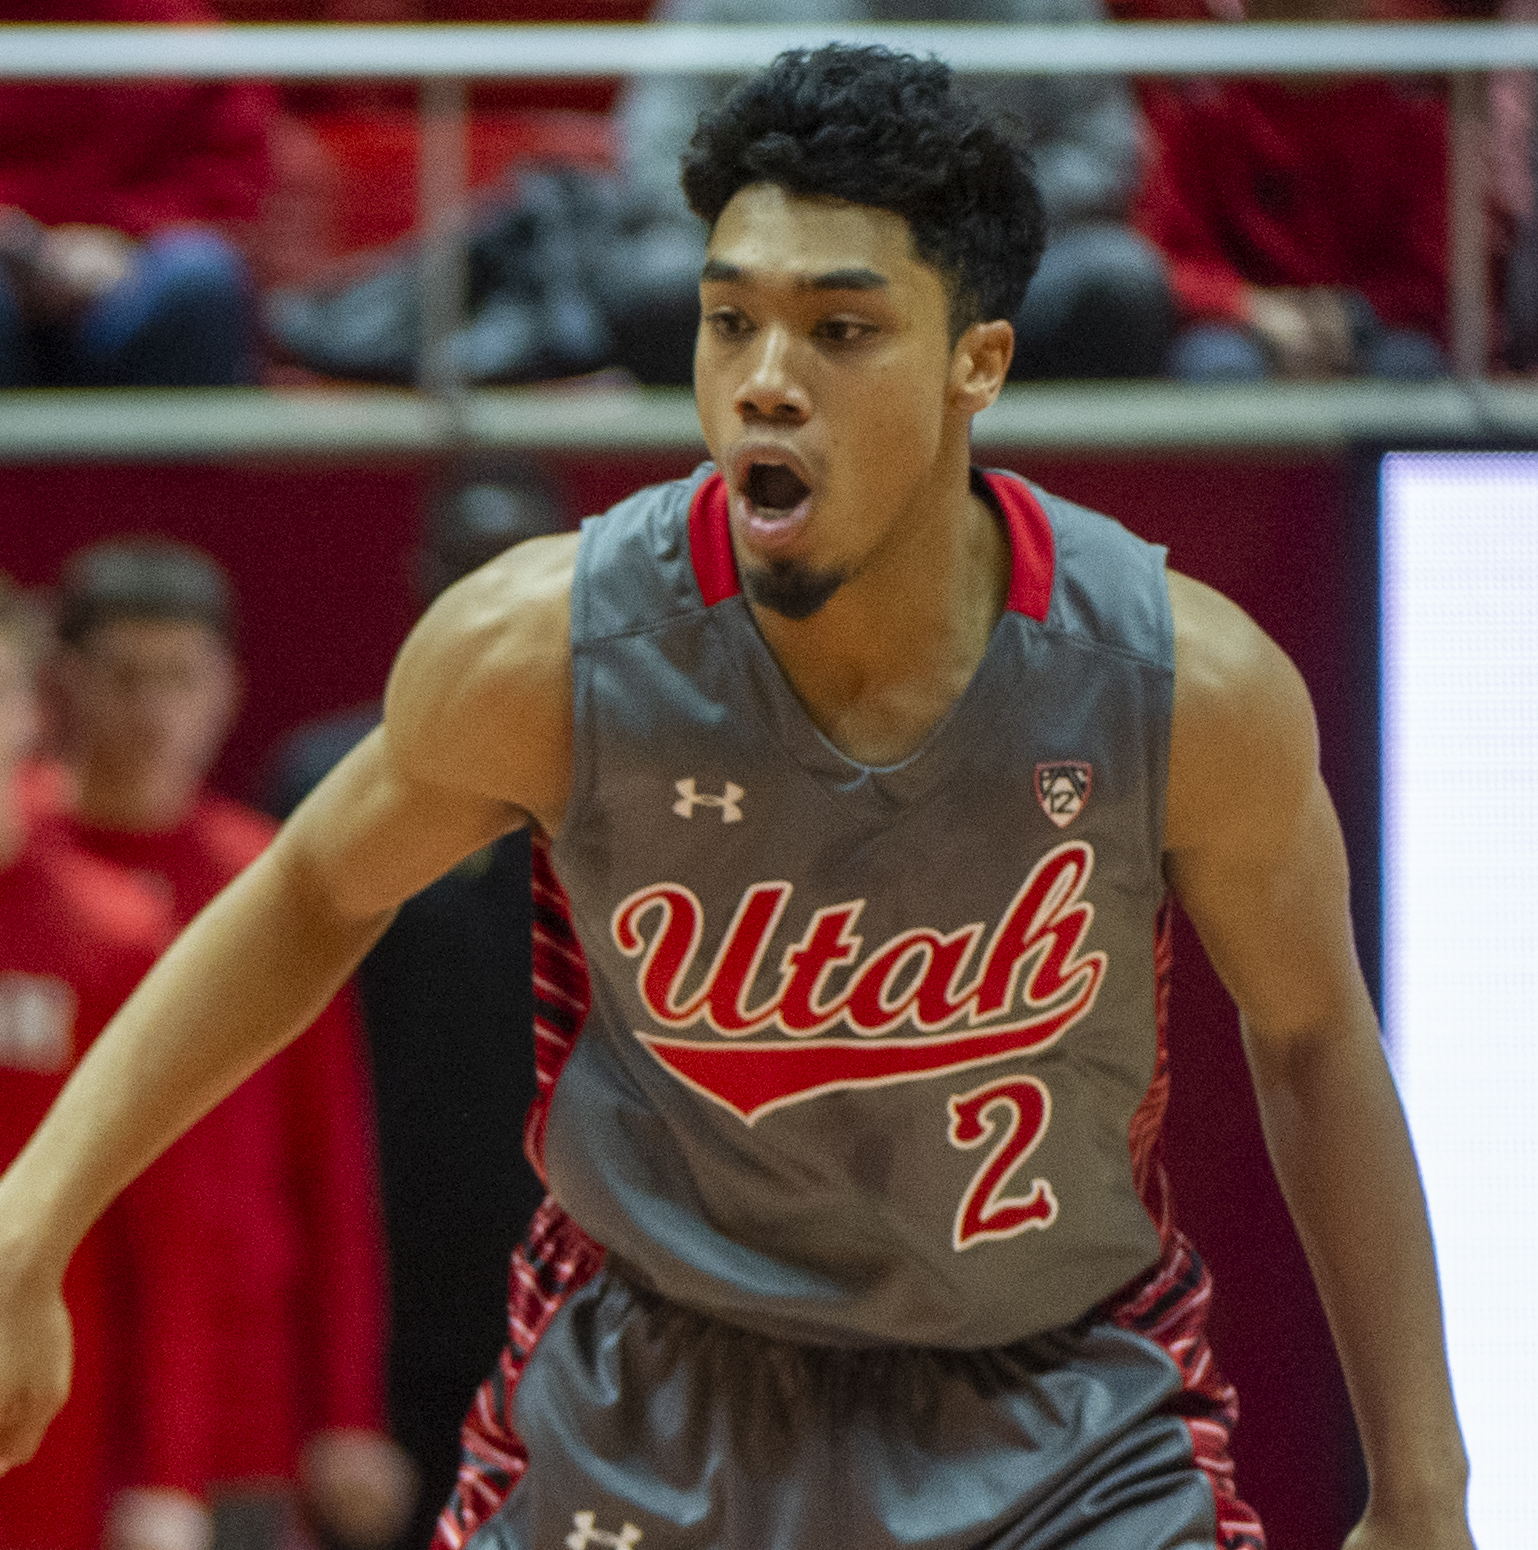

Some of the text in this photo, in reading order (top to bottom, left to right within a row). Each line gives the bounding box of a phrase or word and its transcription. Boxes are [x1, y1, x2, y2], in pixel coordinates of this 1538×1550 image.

[1050, 790, 1077, 814] 12
[611, 840, 1109, 1040] Utah
[947, 1074, 1058, 1252] 2
